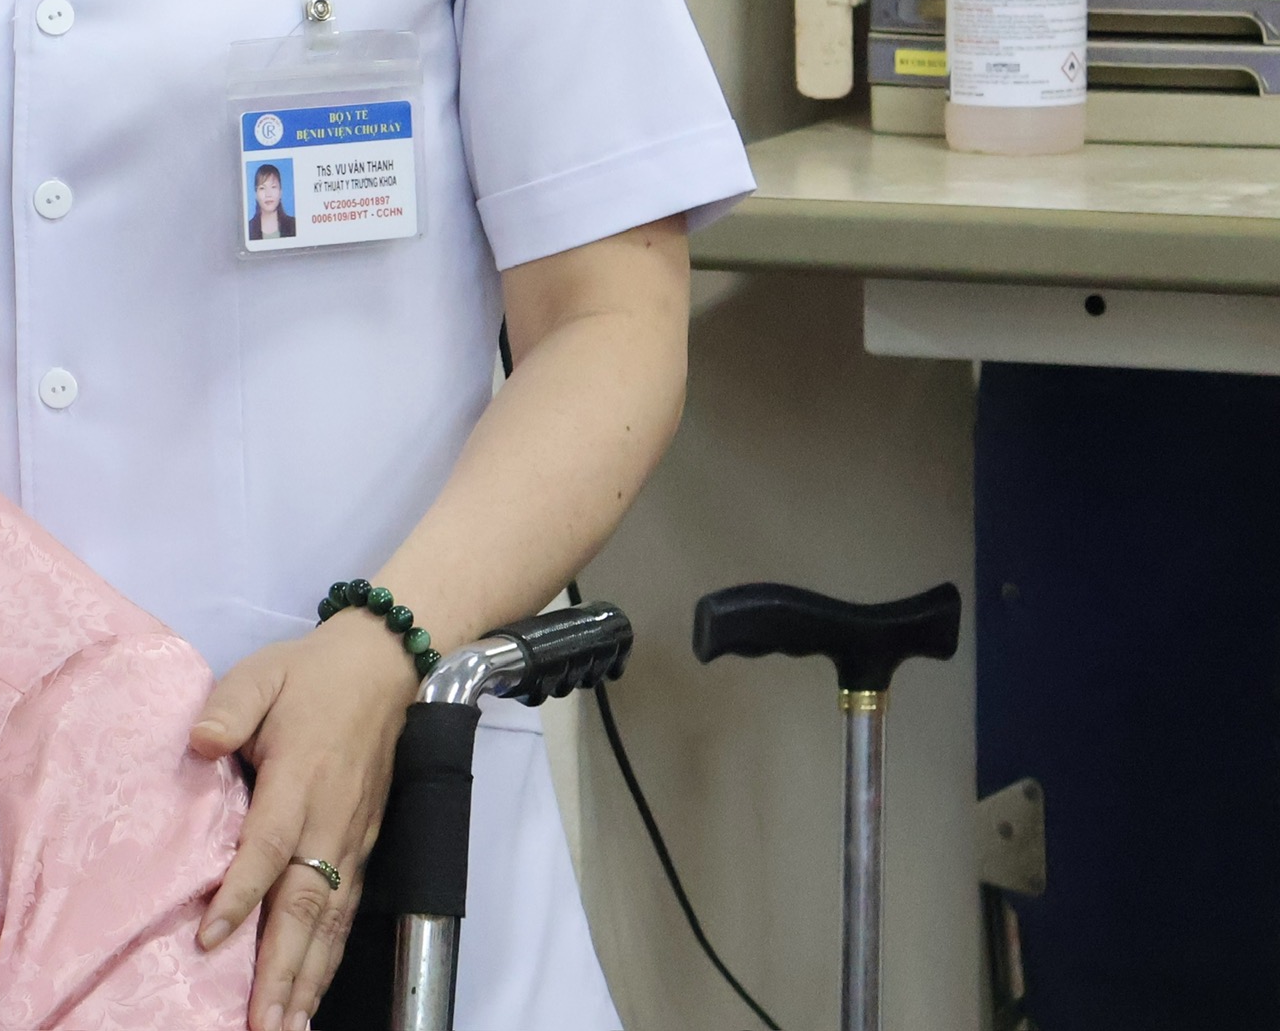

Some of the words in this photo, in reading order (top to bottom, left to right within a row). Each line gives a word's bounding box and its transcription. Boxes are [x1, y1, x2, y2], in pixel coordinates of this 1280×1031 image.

[366, 159, 395, 173] THANH
[379, 175, 397, 188] KHOA
[323, 195, 390, 210] VC2005-001897
[376, 207, 403, 218] CCHN
